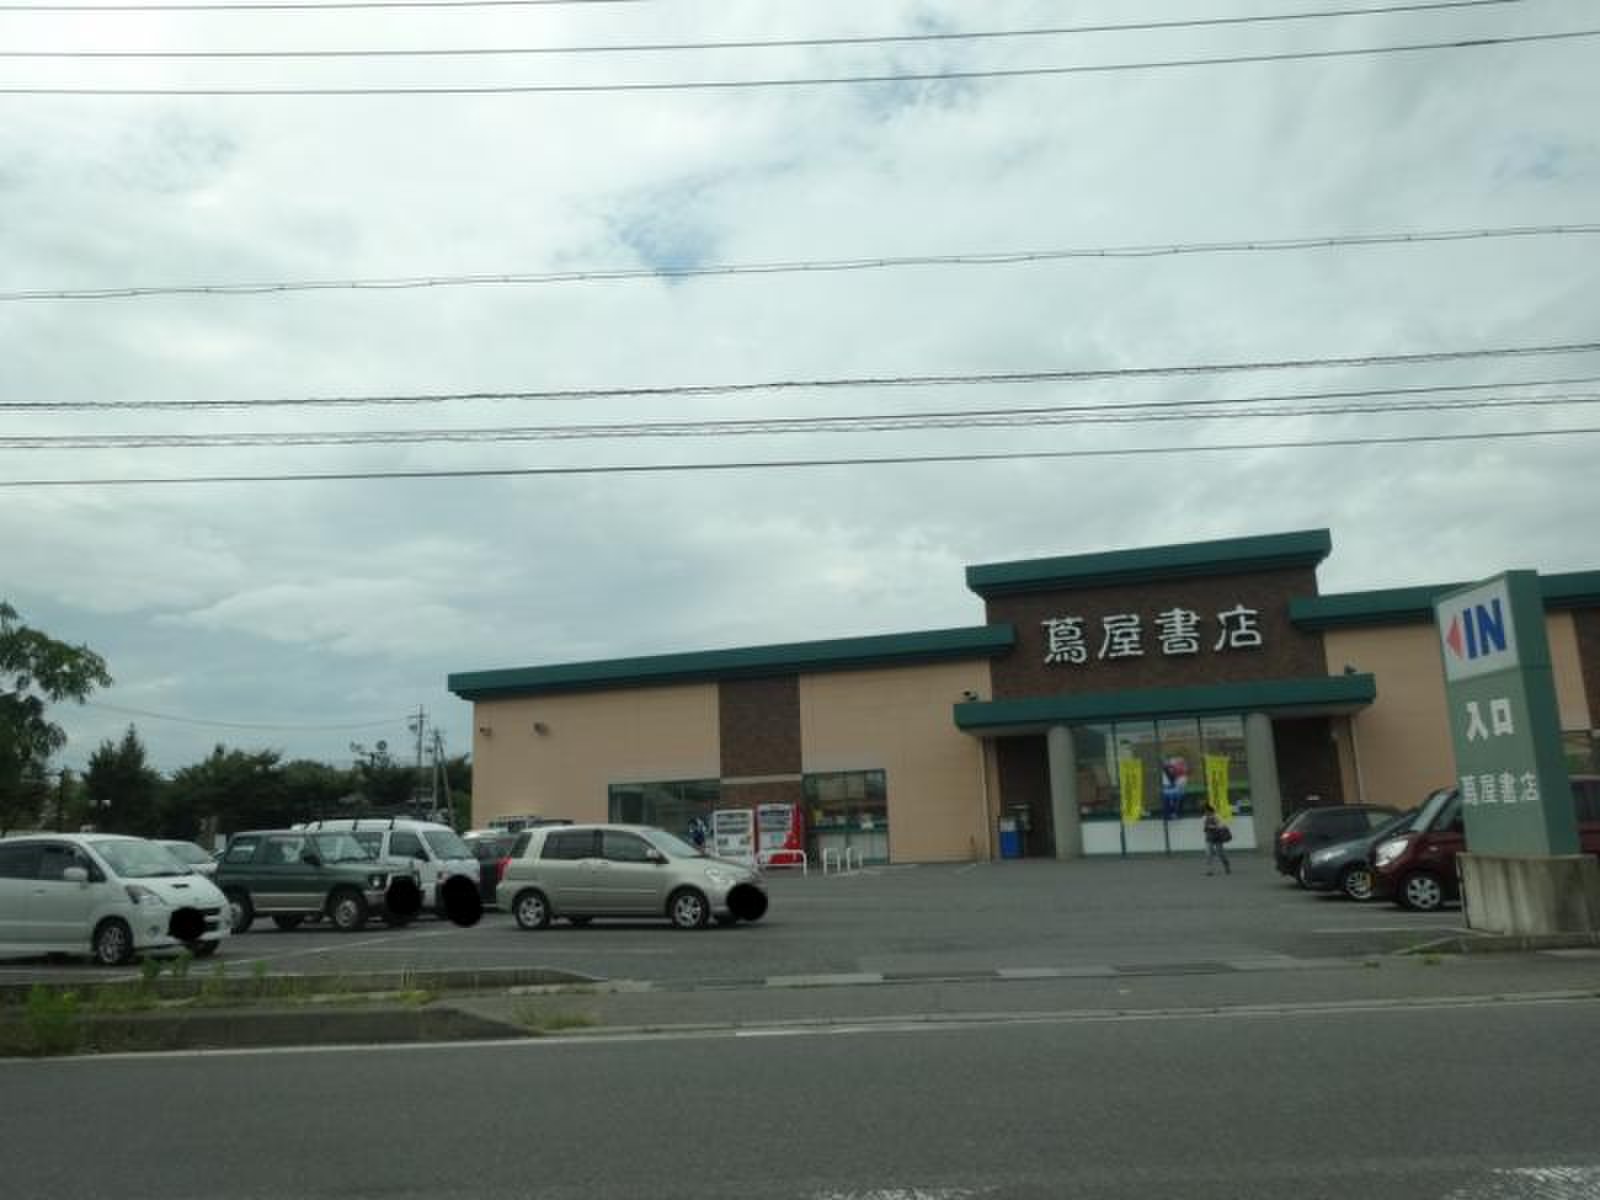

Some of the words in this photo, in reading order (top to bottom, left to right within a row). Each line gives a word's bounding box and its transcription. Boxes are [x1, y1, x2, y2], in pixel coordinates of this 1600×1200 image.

[1040, 603, 1262, 665] 蔦屋書店
[1462, 598, 1507, 660] IN
[1465, 698, 1515, 742] 入口
